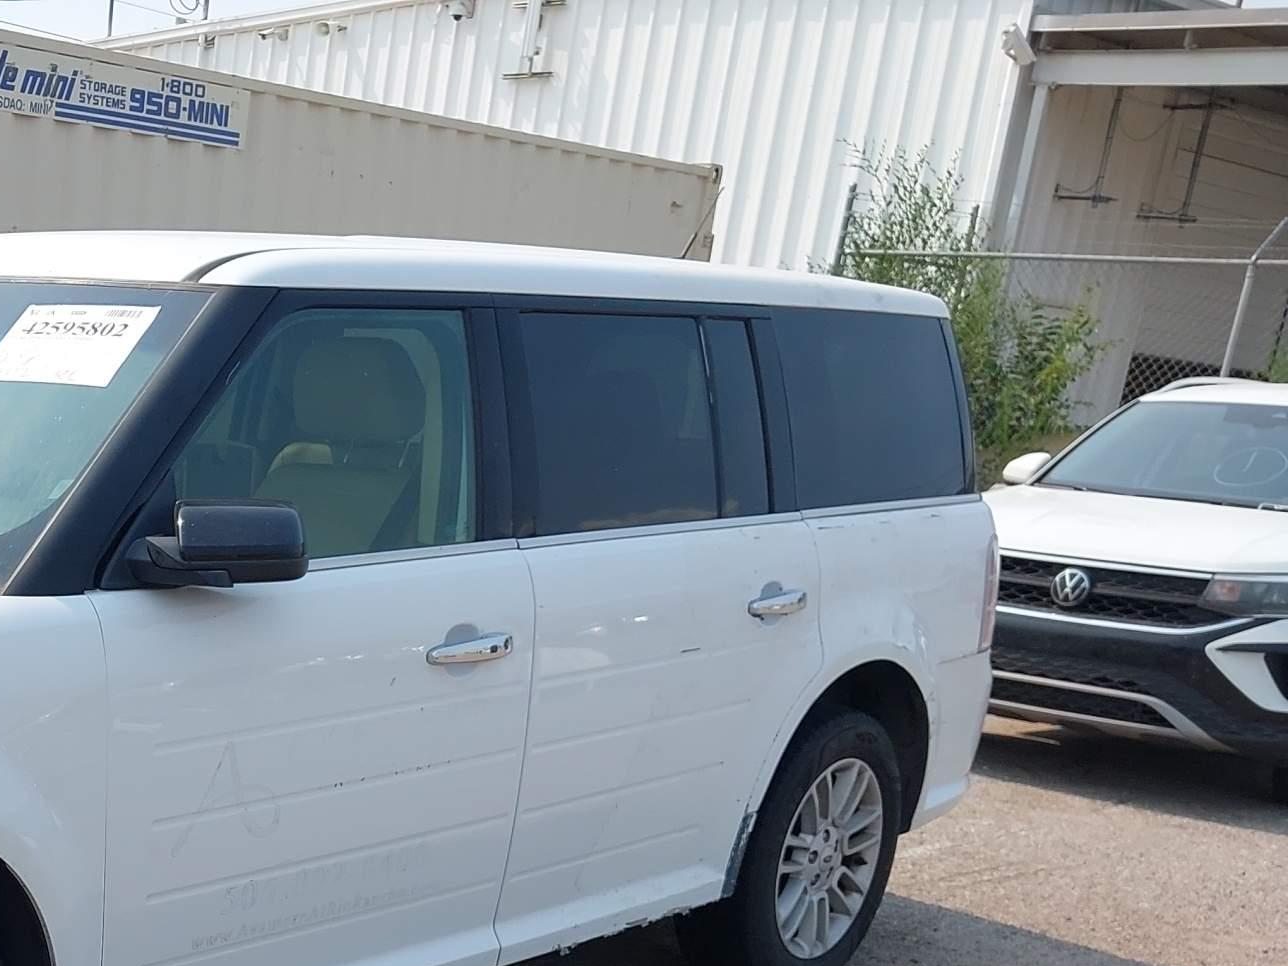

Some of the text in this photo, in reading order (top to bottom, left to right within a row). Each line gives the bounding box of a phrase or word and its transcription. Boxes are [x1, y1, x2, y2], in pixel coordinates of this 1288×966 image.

[20, 63, 79, 101] mini
[80, 79, 127, 97] STORAGE
[79, 92, 126, 110] SYSTEMS
[21, 321, 129, 337] 42595802
